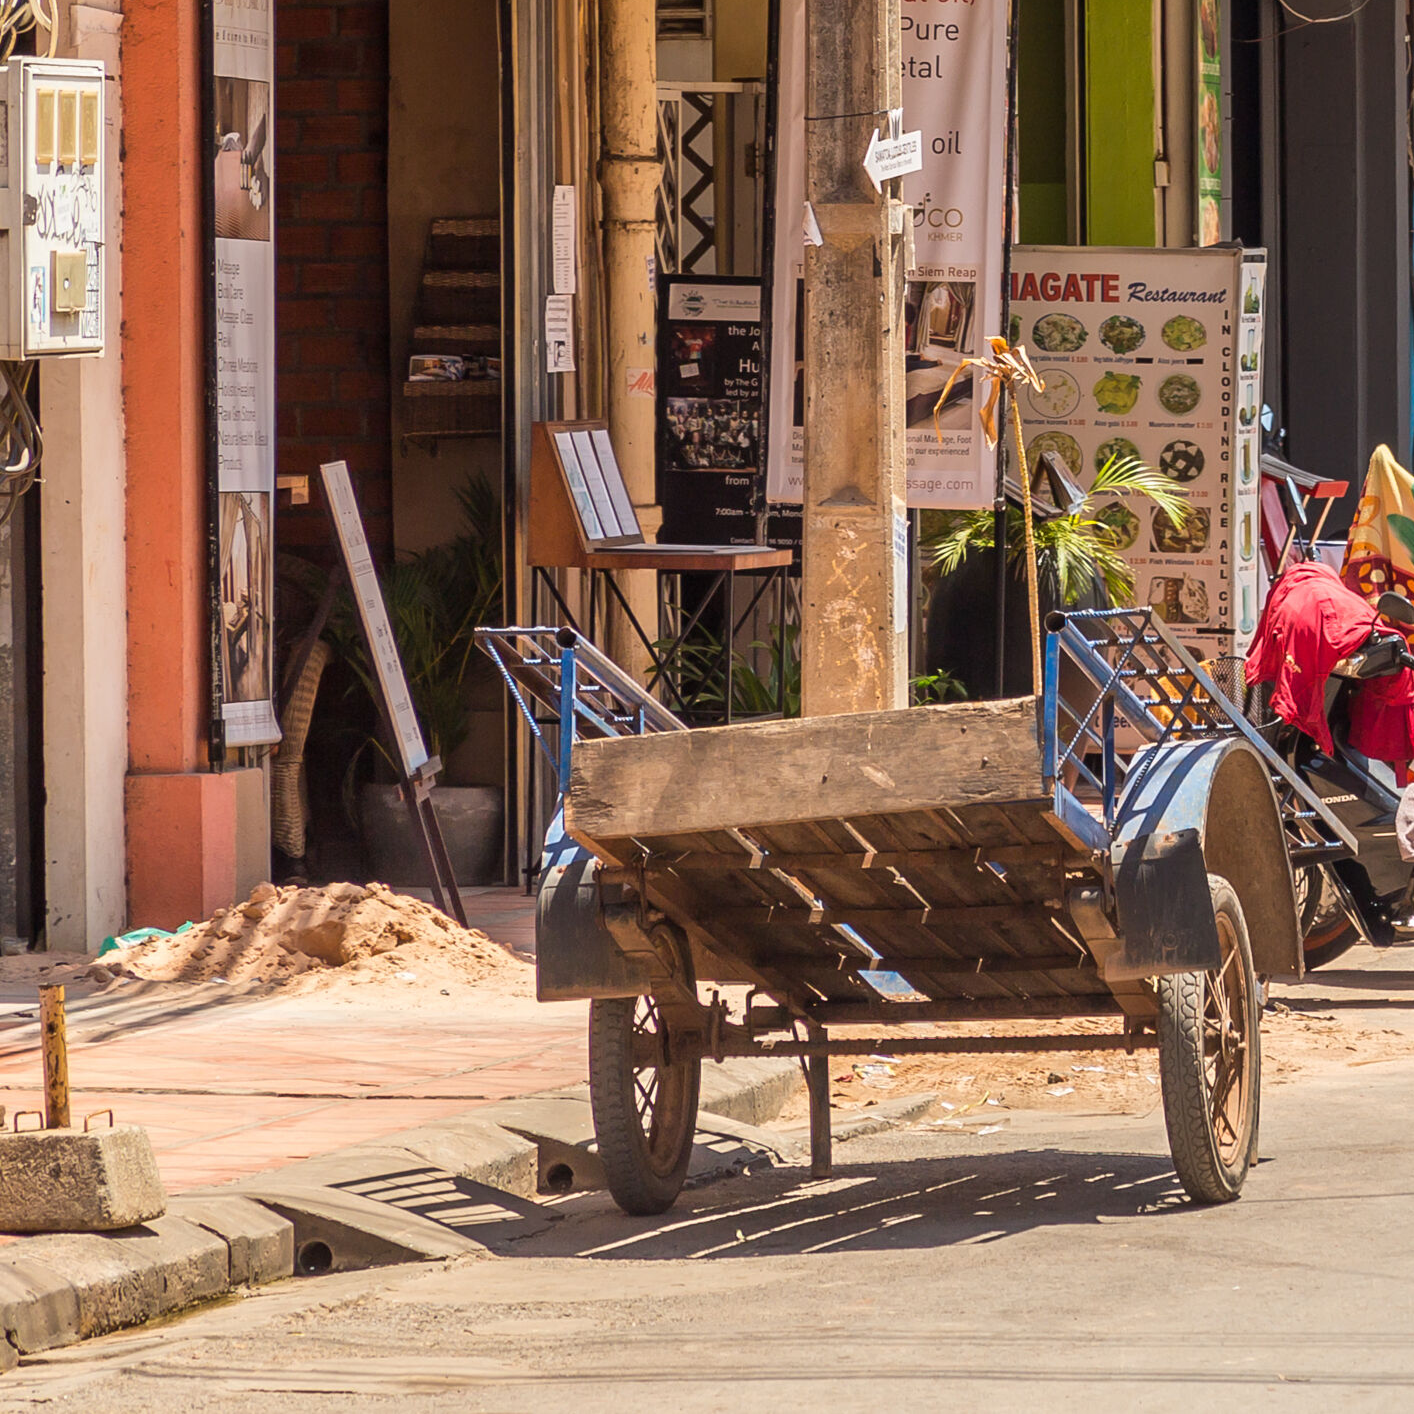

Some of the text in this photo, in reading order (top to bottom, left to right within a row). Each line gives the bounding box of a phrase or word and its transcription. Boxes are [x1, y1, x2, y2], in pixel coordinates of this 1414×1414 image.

[931, 130, 962, 155] oil
[927, 232, 964, 243] KHMER
[917, 266, 978, 279] Siem Reap
[1127, 281, 1228, 305] Restaurant
[725, 475, 750, 486] from
